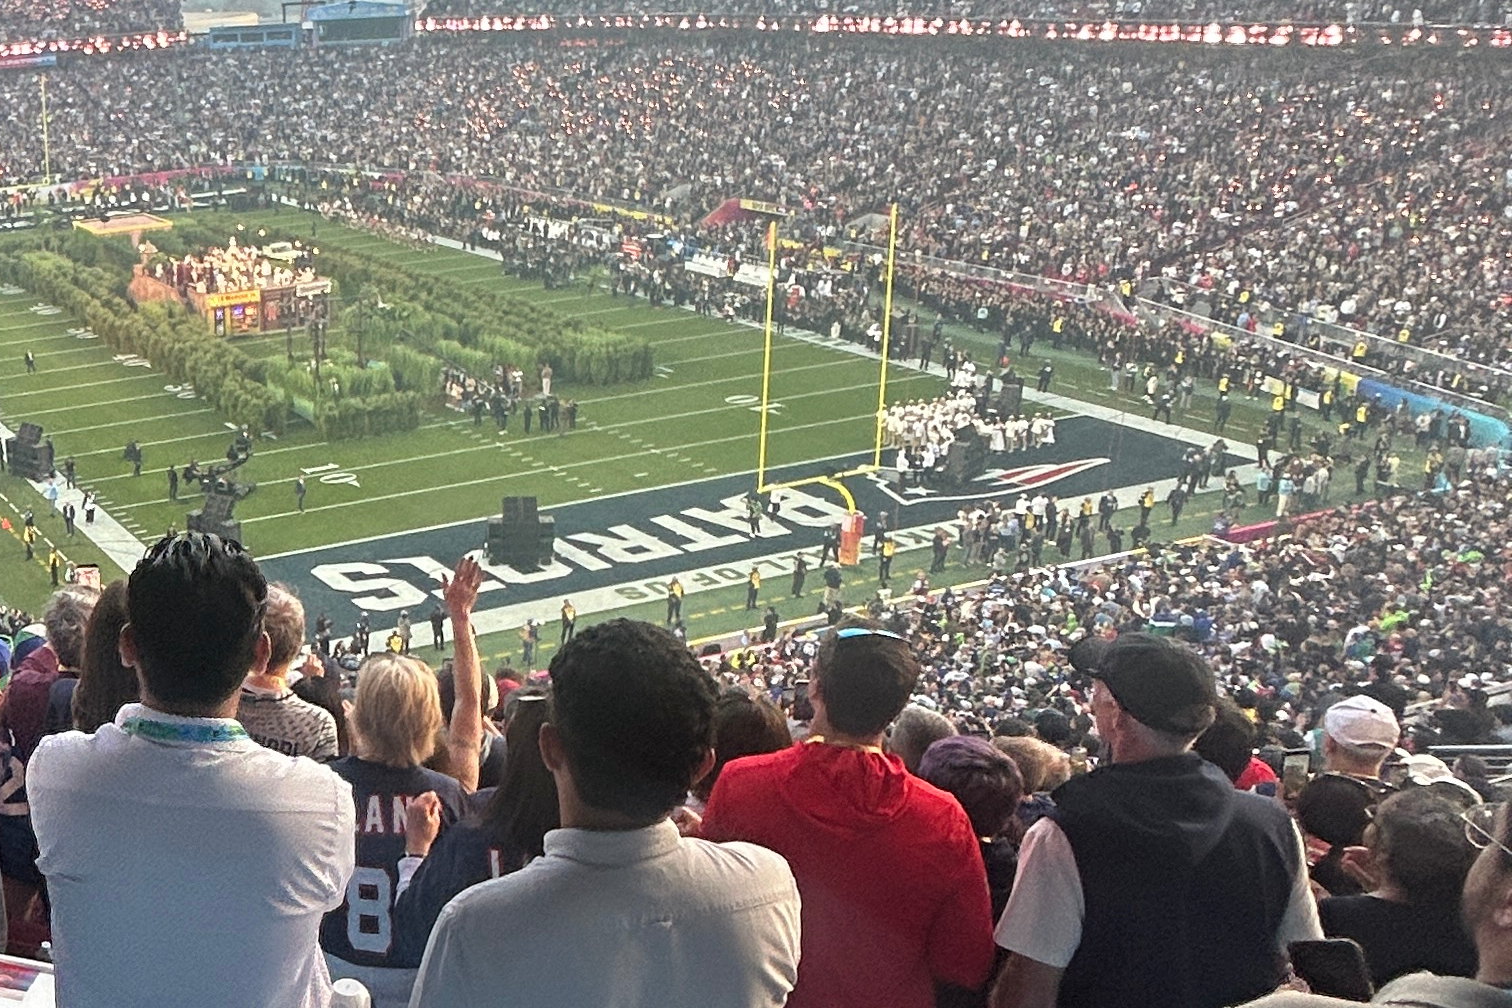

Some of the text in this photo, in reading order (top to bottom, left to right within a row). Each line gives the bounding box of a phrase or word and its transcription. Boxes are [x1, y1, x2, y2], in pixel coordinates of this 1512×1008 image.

[725, 395, 785, 415] 10
[300, 463, 358, 486] 10
[692, 567, 747, 587] OF
[614, 581, 670, 600] US
[356, 795, 413, 833] AN
